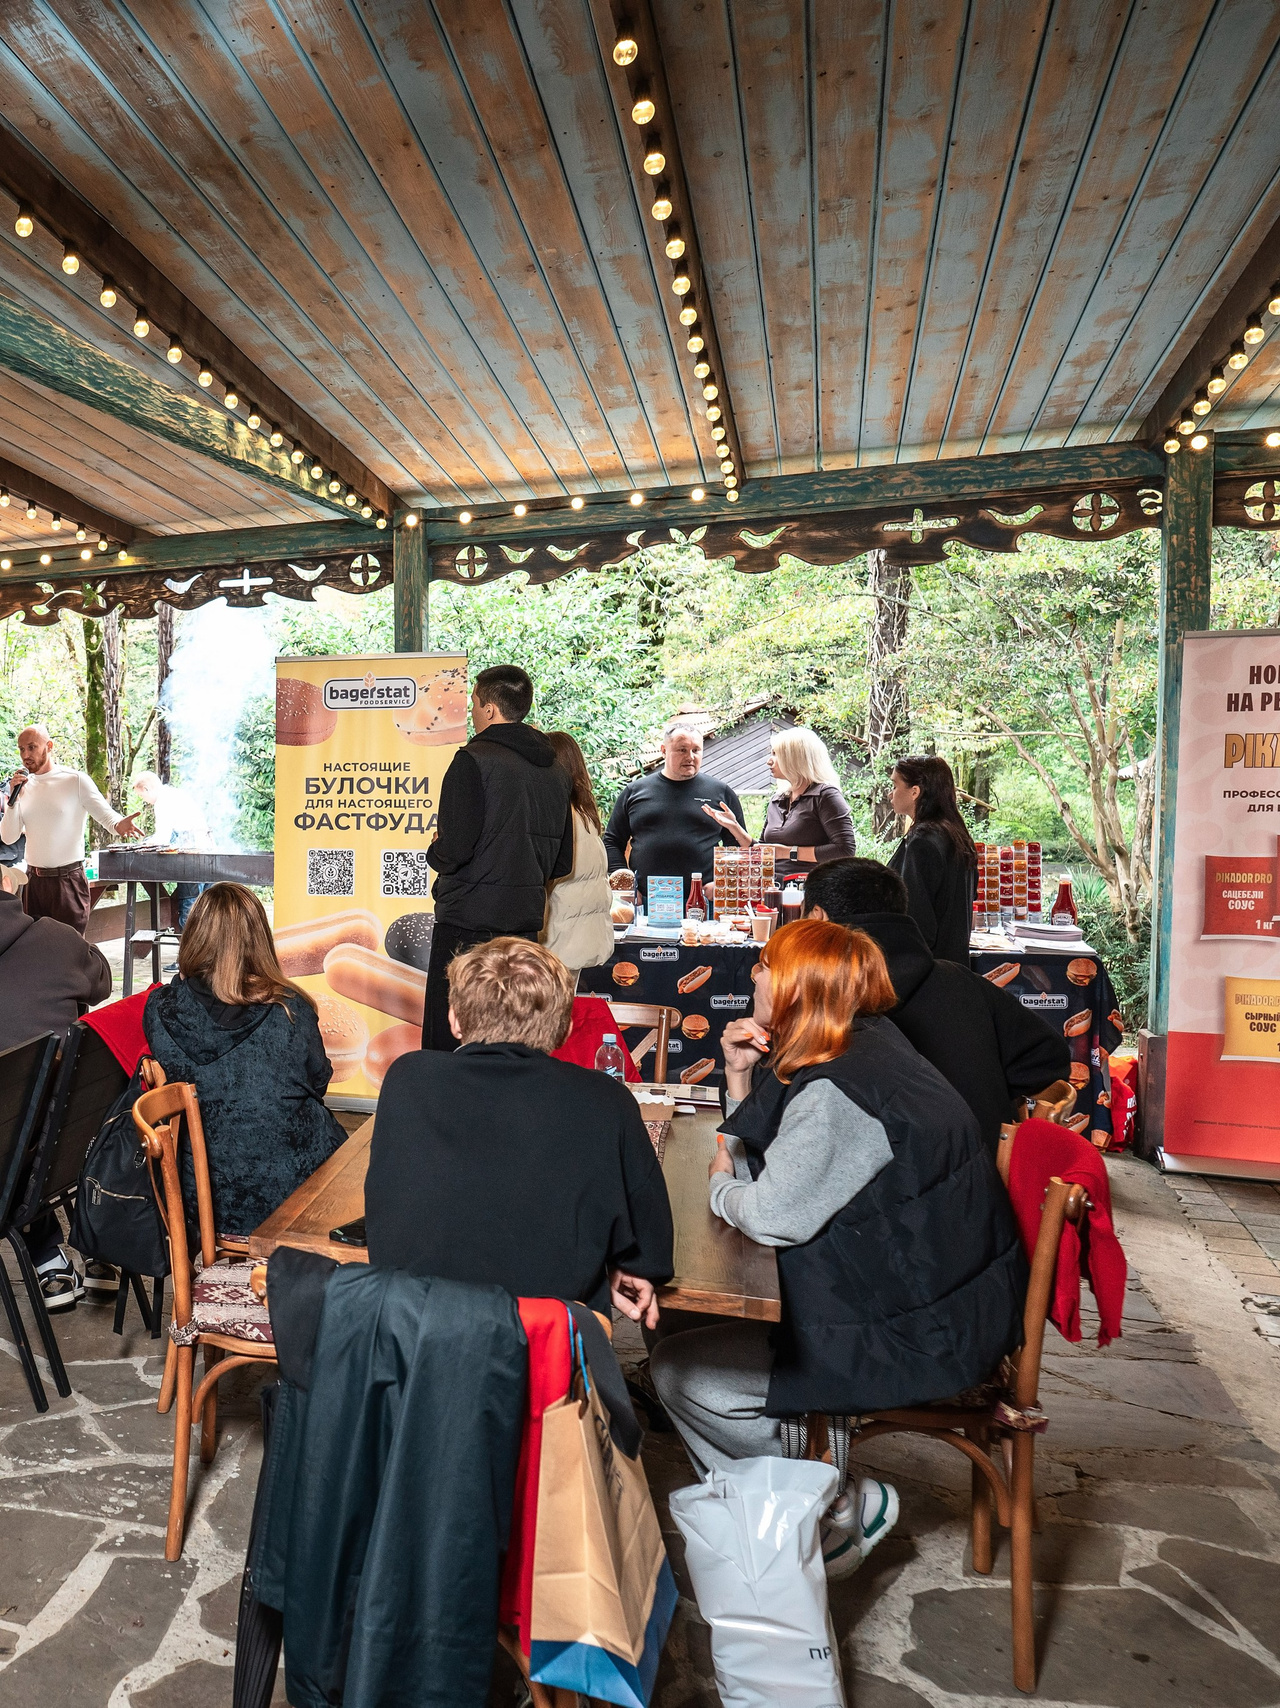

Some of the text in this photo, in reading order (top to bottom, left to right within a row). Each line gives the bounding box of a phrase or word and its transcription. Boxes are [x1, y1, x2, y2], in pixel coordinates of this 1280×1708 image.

[1249, 664, 1280, 685] НО
[329, 686, 410, 702] bagerstat
[1226, 692, 1254, 712] НА
[323, 762, 411, 773] НАСТОЯЩИЕ
[305, 777, 429, 795] БУЛОЧКИ
[305, 799, 433, 810] ДЛЯ НАСТОЯЩЕГО
[1247, 804, 1274, 813] ДЛЯ
[294, 812, 438, 834] ФАСТФУДА
[1216, 872, 1273, 884] PIKADOR PRO
[1222, 890, 1264, 899] САЦЕБЕЛИ
[1228, 900, 1256, 910] СОУС
[1255, 919, 1261, 930] 1
[642, 950, 677, 959] bagerstat
[713, 998, 748, 1006] bagerstat
[1023, 997, 1065, 1006] bagerstat
[1235, 994, 1274, 1006] PIKADOR
[1249, 1022, 1277, 1033] СОУС
